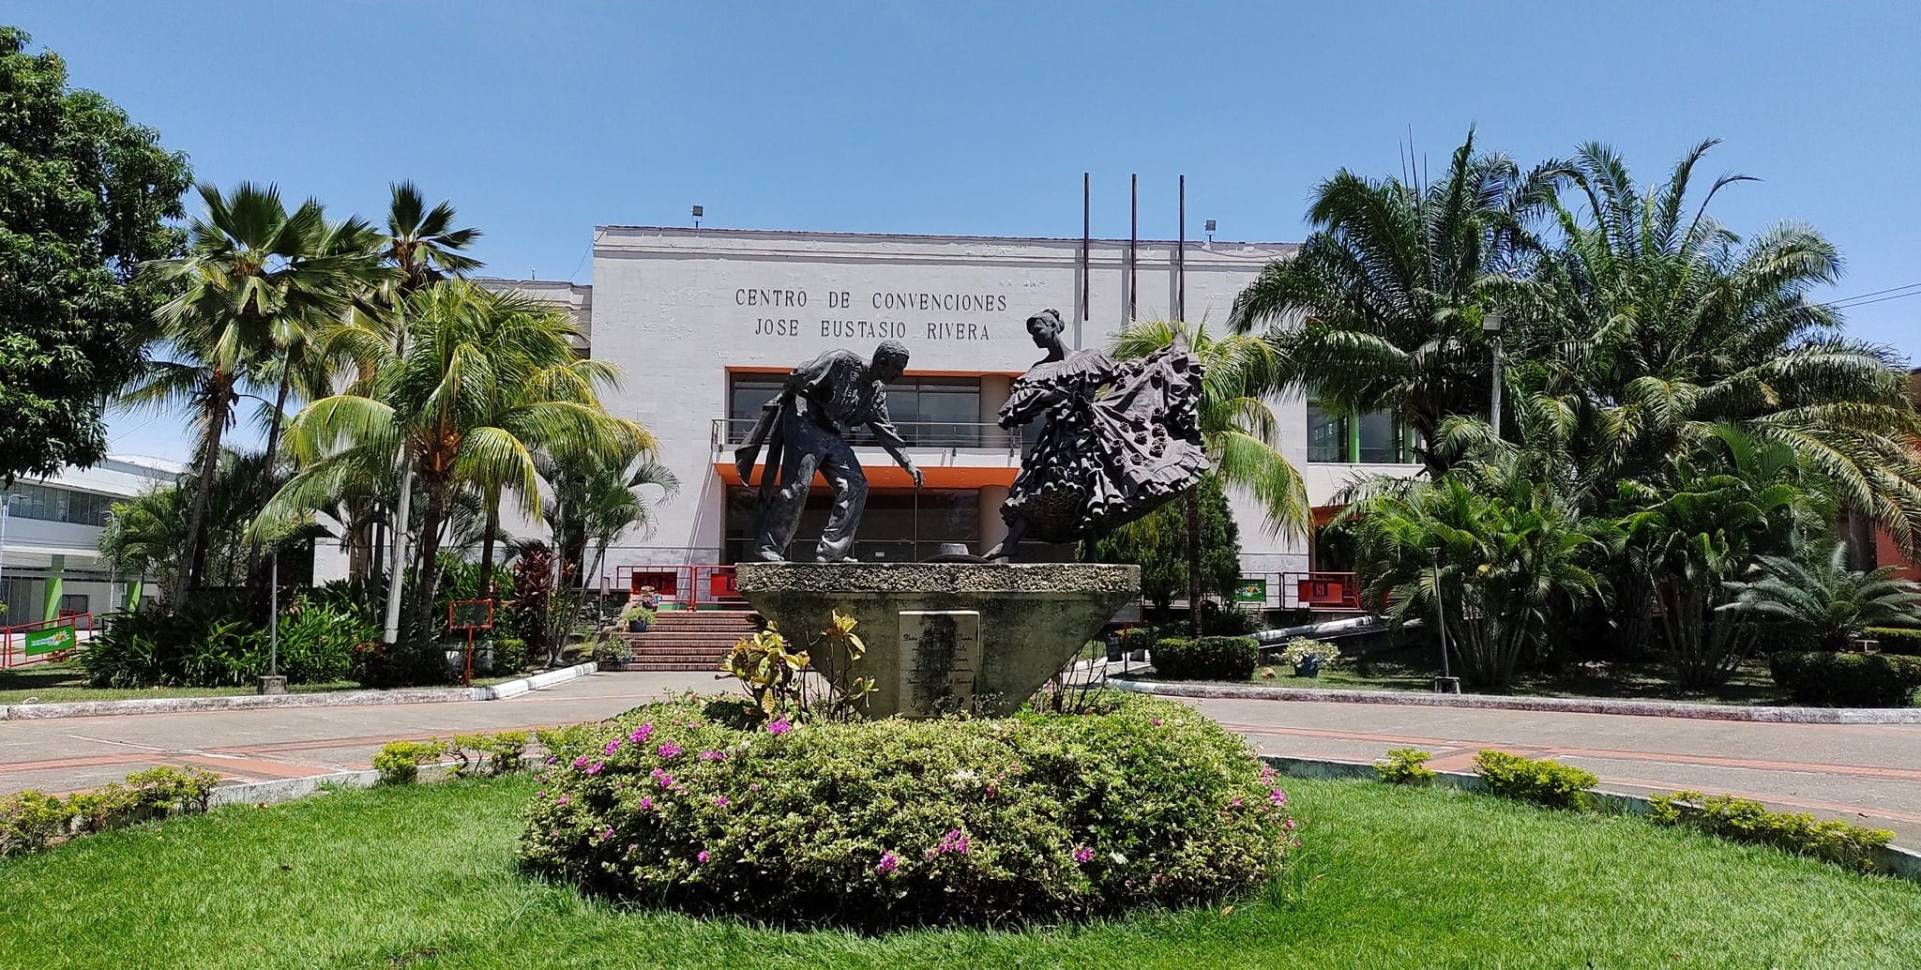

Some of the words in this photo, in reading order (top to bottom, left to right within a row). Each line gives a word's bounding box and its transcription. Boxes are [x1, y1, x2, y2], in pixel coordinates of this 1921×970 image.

[735, 288, 807, 307] CENTRO
[829, 291, 850, 308] DE
[872, 292, 1007, 311] CONVENCIONES
[755, 318, 799, 336] JOSE
[821, 320, 906, 338] EUSTASIO
[927, 322, 989, 340] RIVERA
